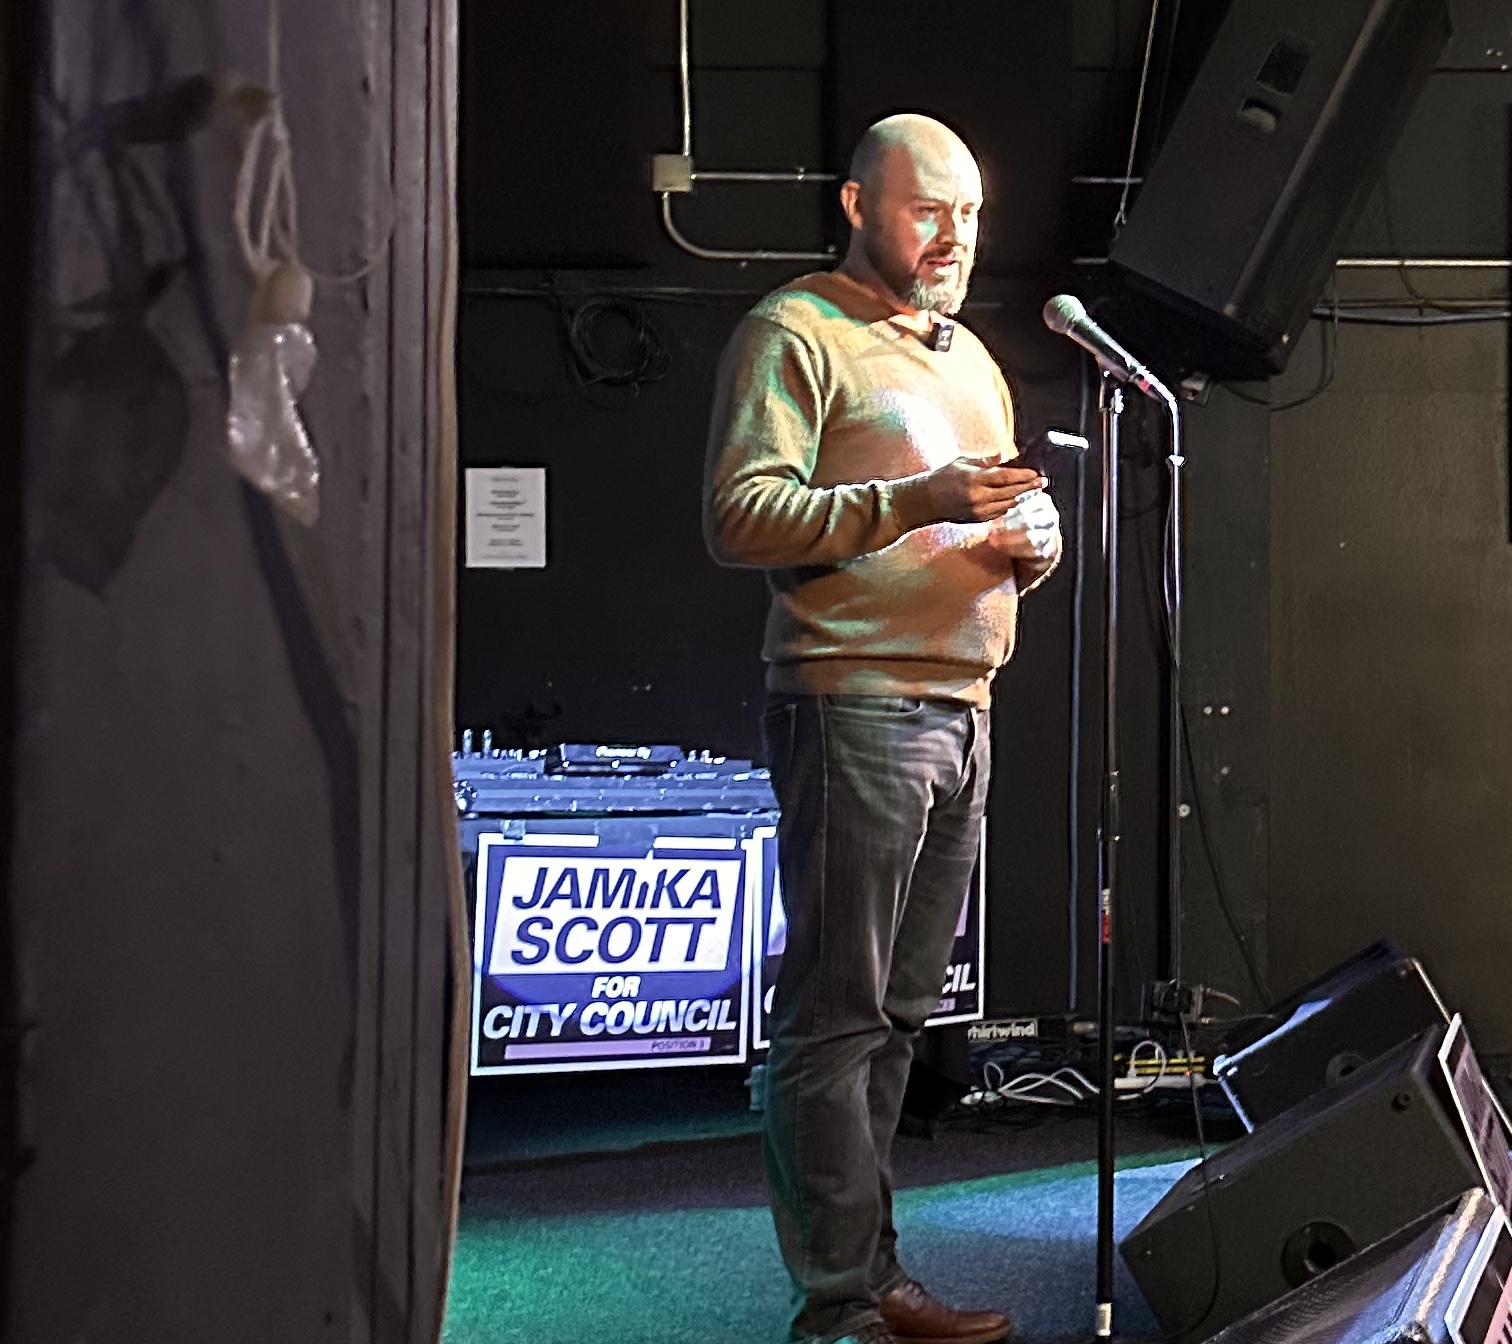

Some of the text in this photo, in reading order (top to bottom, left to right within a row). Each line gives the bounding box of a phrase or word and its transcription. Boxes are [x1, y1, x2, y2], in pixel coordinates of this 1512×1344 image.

[511, 915, 717, 964] SCOTT
[592, 975, 641, 998] FOR
[483, 1002, 577, 1040] CITY
[580, 999, 737, 1036] COUNCIL
